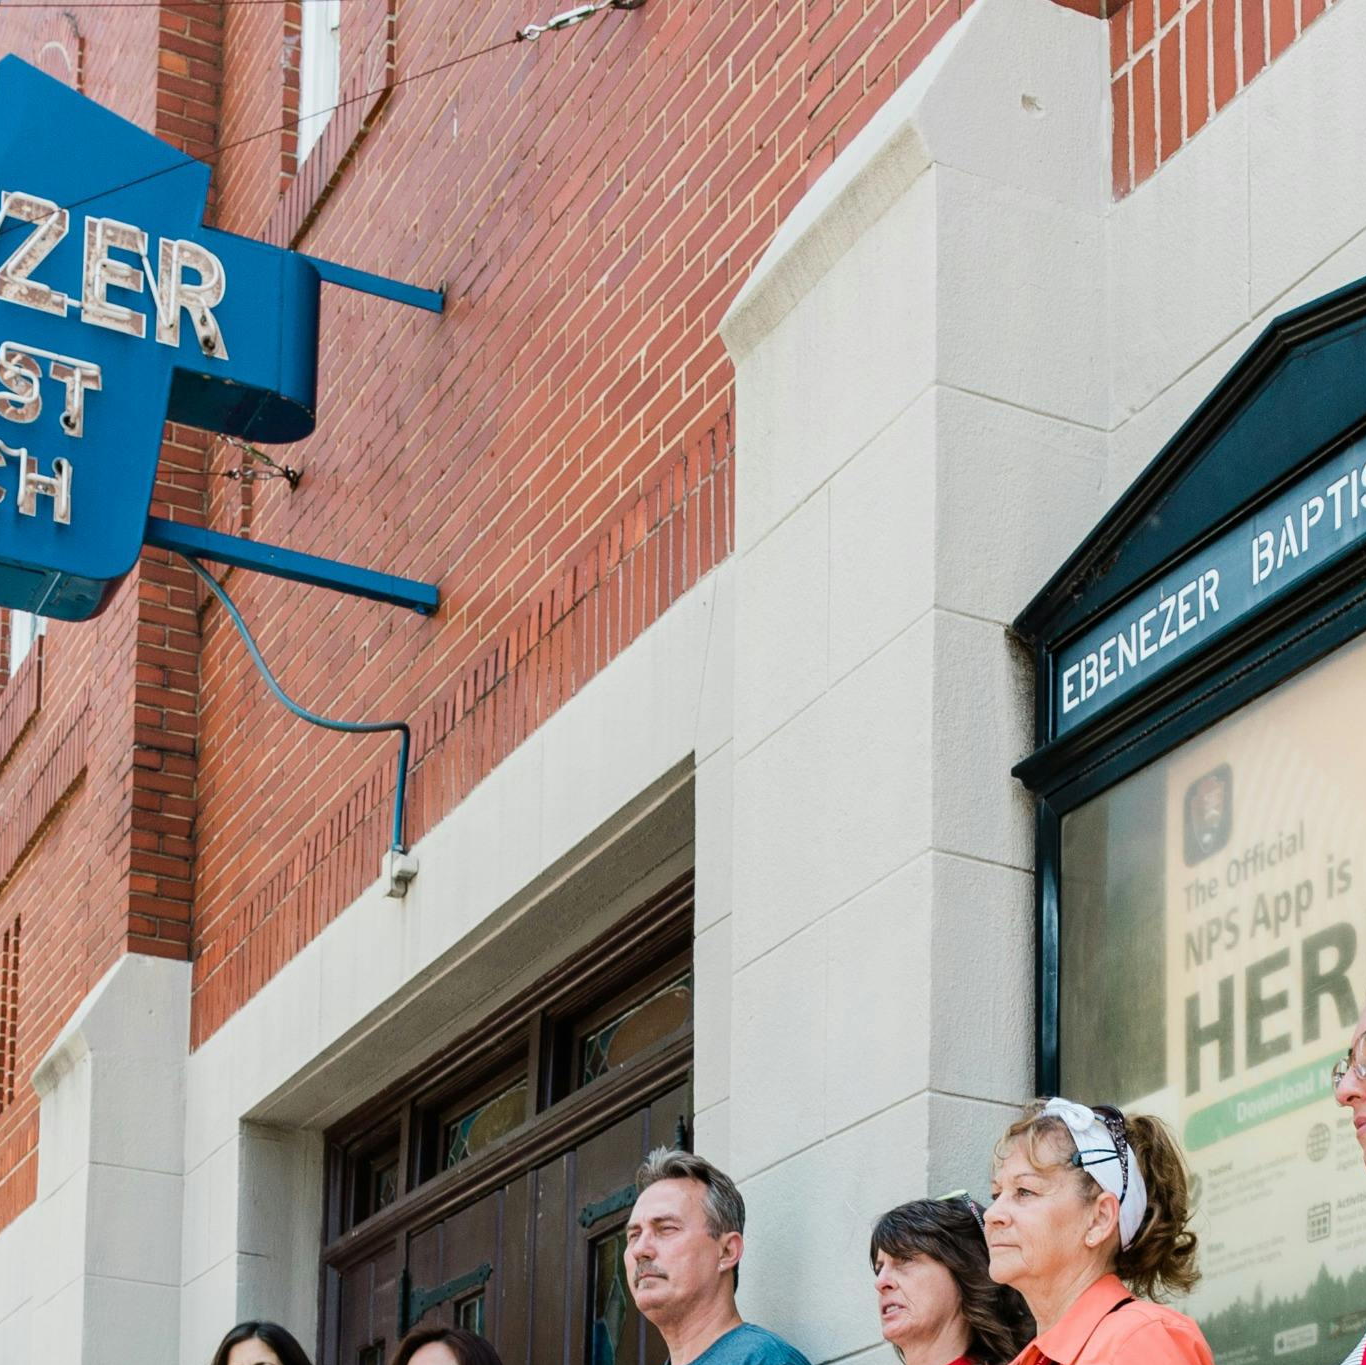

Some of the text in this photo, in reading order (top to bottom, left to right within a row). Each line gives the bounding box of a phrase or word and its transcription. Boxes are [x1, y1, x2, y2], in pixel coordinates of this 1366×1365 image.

[1062, 568, 1221, 715] EBENEZER
[1184, 819, 1305, 913] The Official
[1184, 854, 1353, 972] NPS App is
